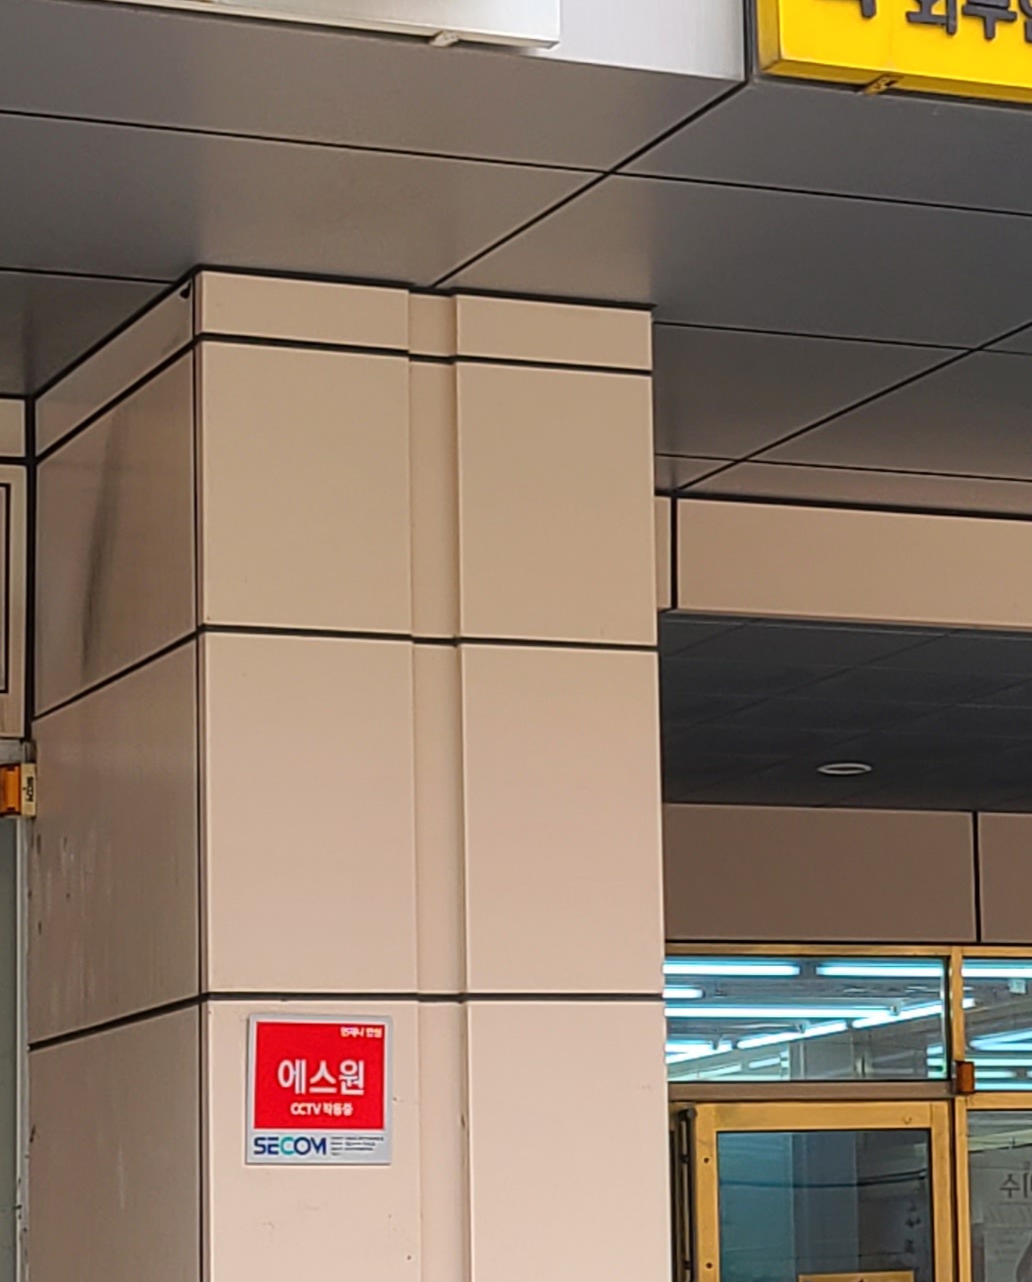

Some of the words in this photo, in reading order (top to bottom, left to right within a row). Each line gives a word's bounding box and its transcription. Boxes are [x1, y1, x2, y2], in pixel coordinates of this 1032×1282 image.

[277, 1058, 365, 1096] 에스원
[290, 1102, 321, 1116] CCTV
[253, 1136, 328, 1156] SECOM
